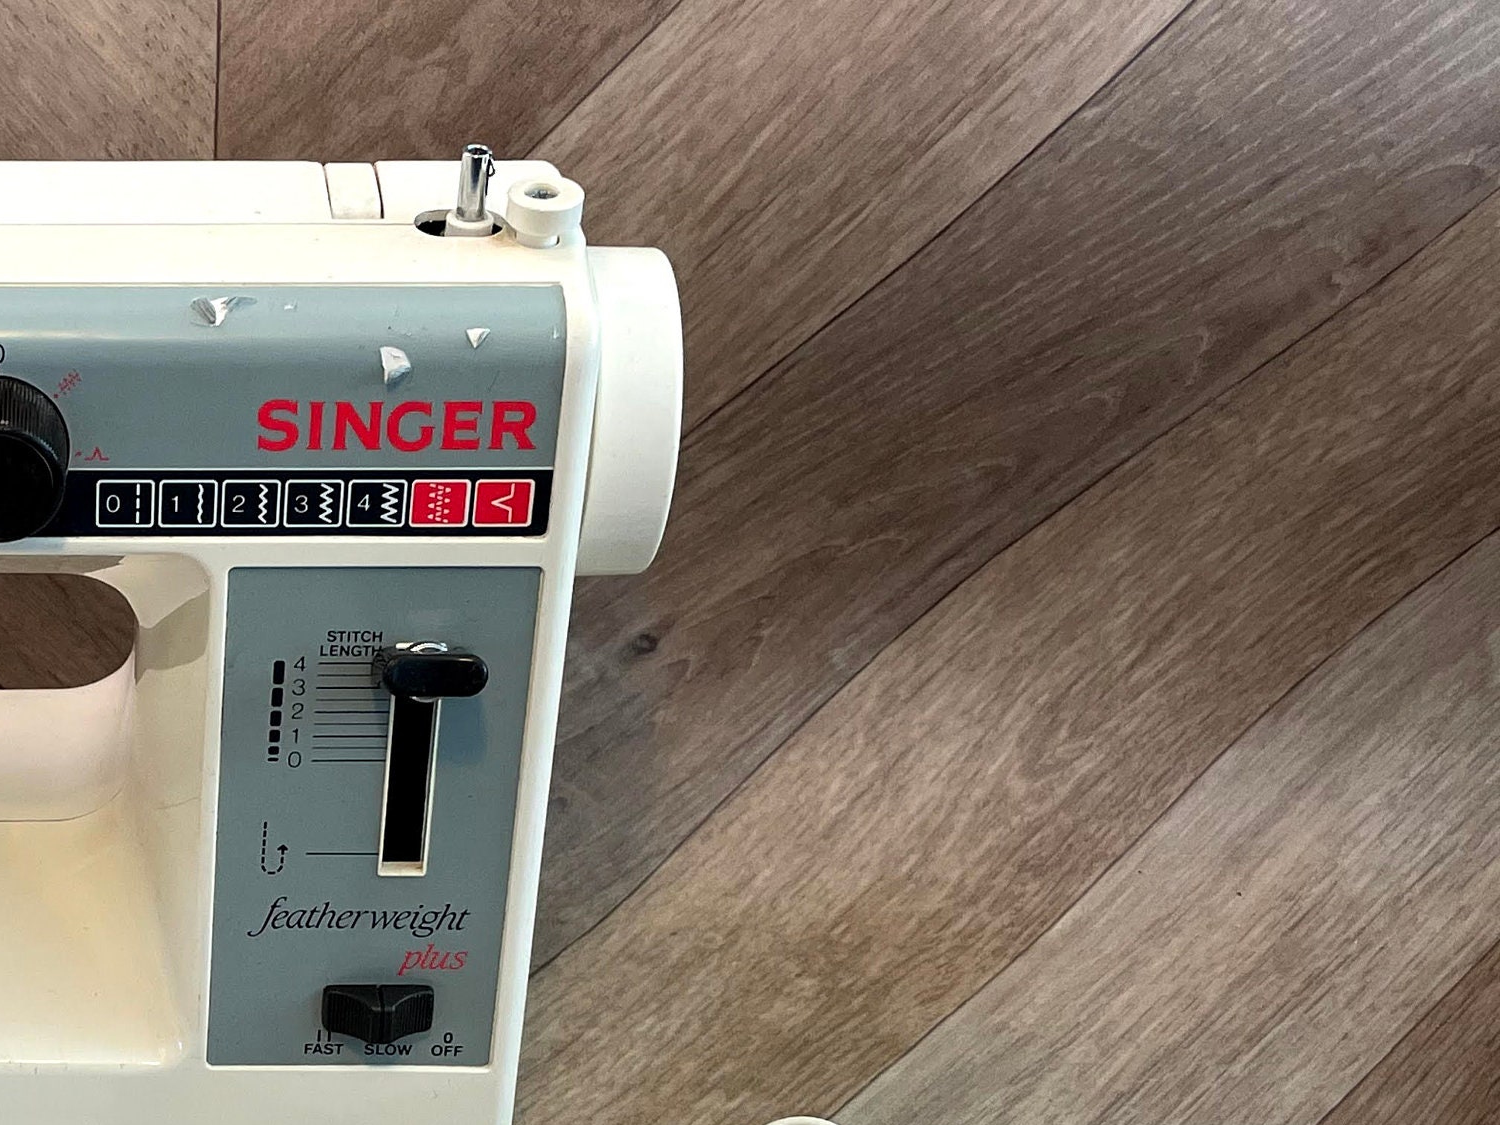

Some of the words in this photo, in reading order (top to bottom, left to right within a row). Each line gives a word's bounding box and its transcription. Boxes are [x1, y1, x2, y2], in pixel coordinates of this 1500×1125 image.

[256, 399, 538, 453] SINGER
[105, 493, 121, 514] 0
[171, 494, 180, 514] 1
[231, 493, 246, 514] 2
[293, 493, 309, 514] 3
[356, 493, 371, 513] 4
[326, 630, 383, 643] STITCH
[319, 645, 383, 657] LENGTH
[293, 655, 306, 672] 4
[291, 678, 306, 696] 3
[291, 702, 304, 720] 2
[291, 728, 299, 744] 1
[287, 751, 302, 769] 0
[246, 896, 471, 938] featherweight
[397, 943, 468, 977] plus
[303, 1043, 344, 1055] FAST
[364, 1044, 413, 1056] SLOW
[430, 1044, 464, 1057] OFF
